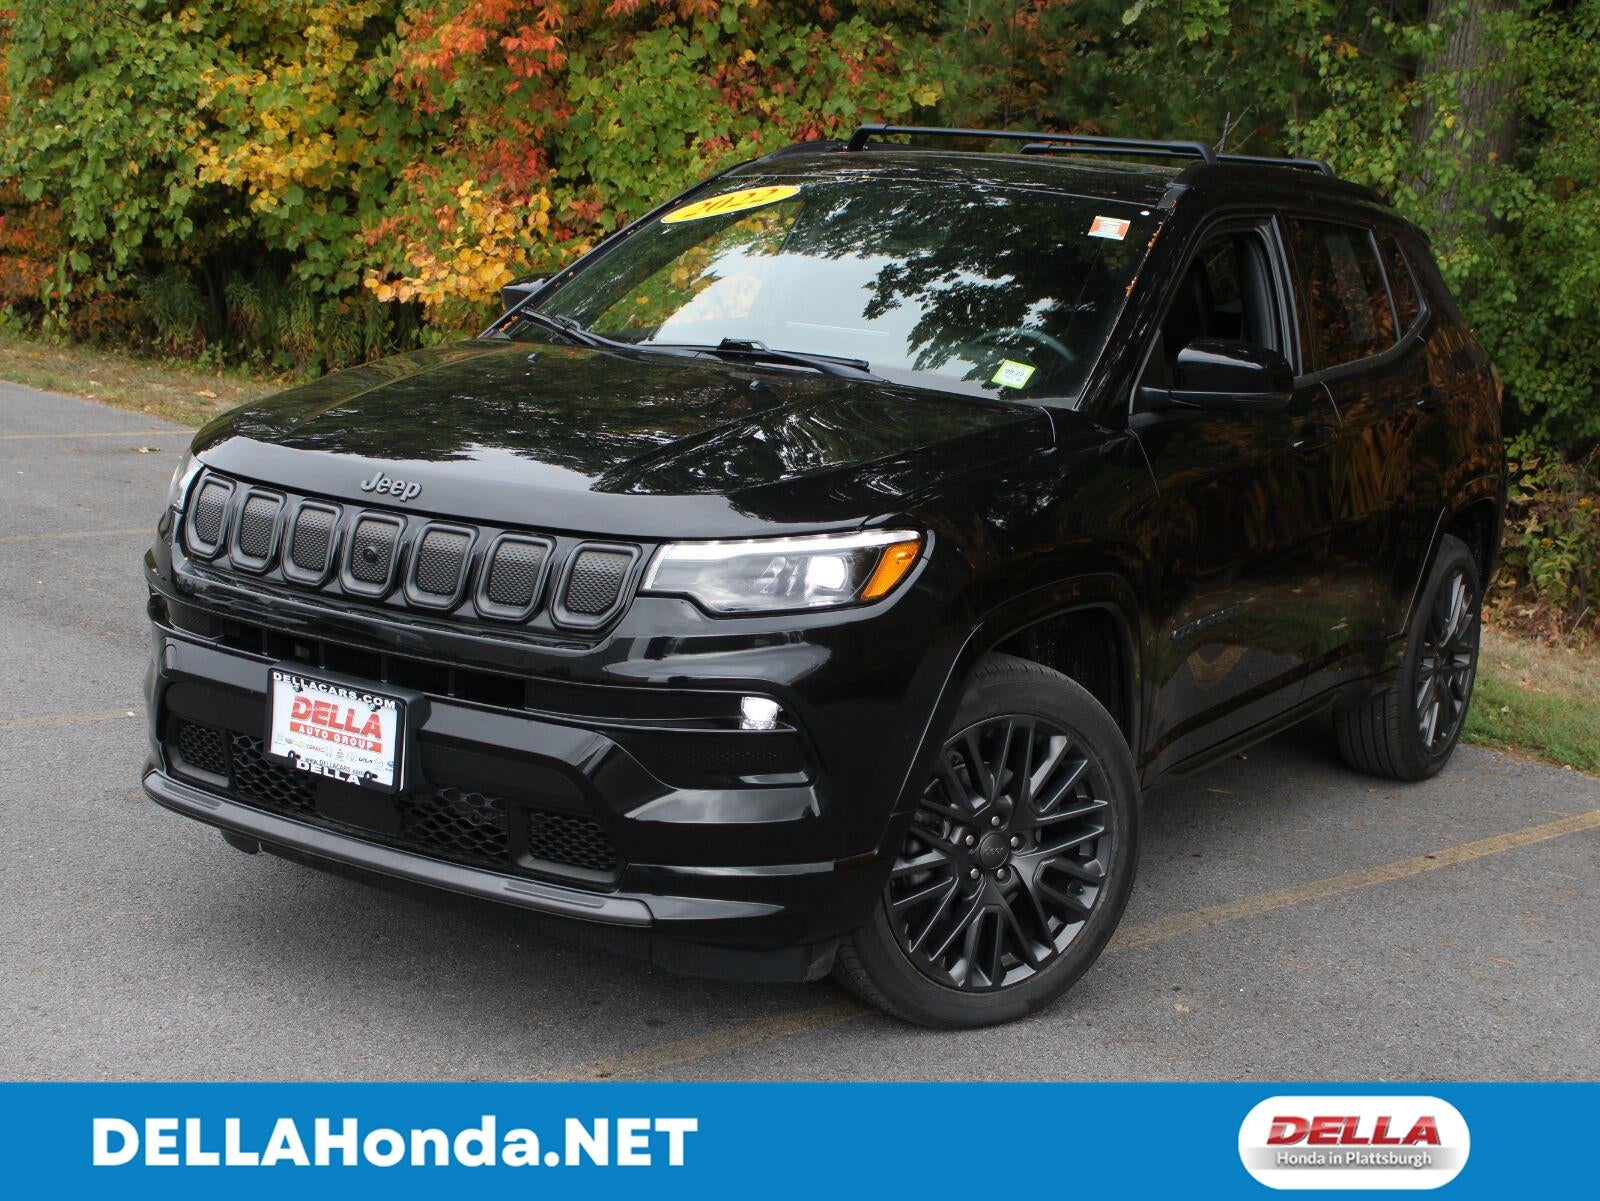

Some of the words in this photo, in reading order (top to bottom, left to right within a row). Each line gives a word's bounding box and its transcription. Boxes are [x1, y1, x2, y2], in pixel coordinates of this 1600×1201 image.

[360, 471, 422, 503] Jeep
[273, 671, 396, 709] DELLACARS.COM
[291, 695, 382, 740] DELLA
[298, 722, 329, 739] AUTO
[333, 734, 374, 750] GROUP
[296, 759, 361, 786] DELLA
